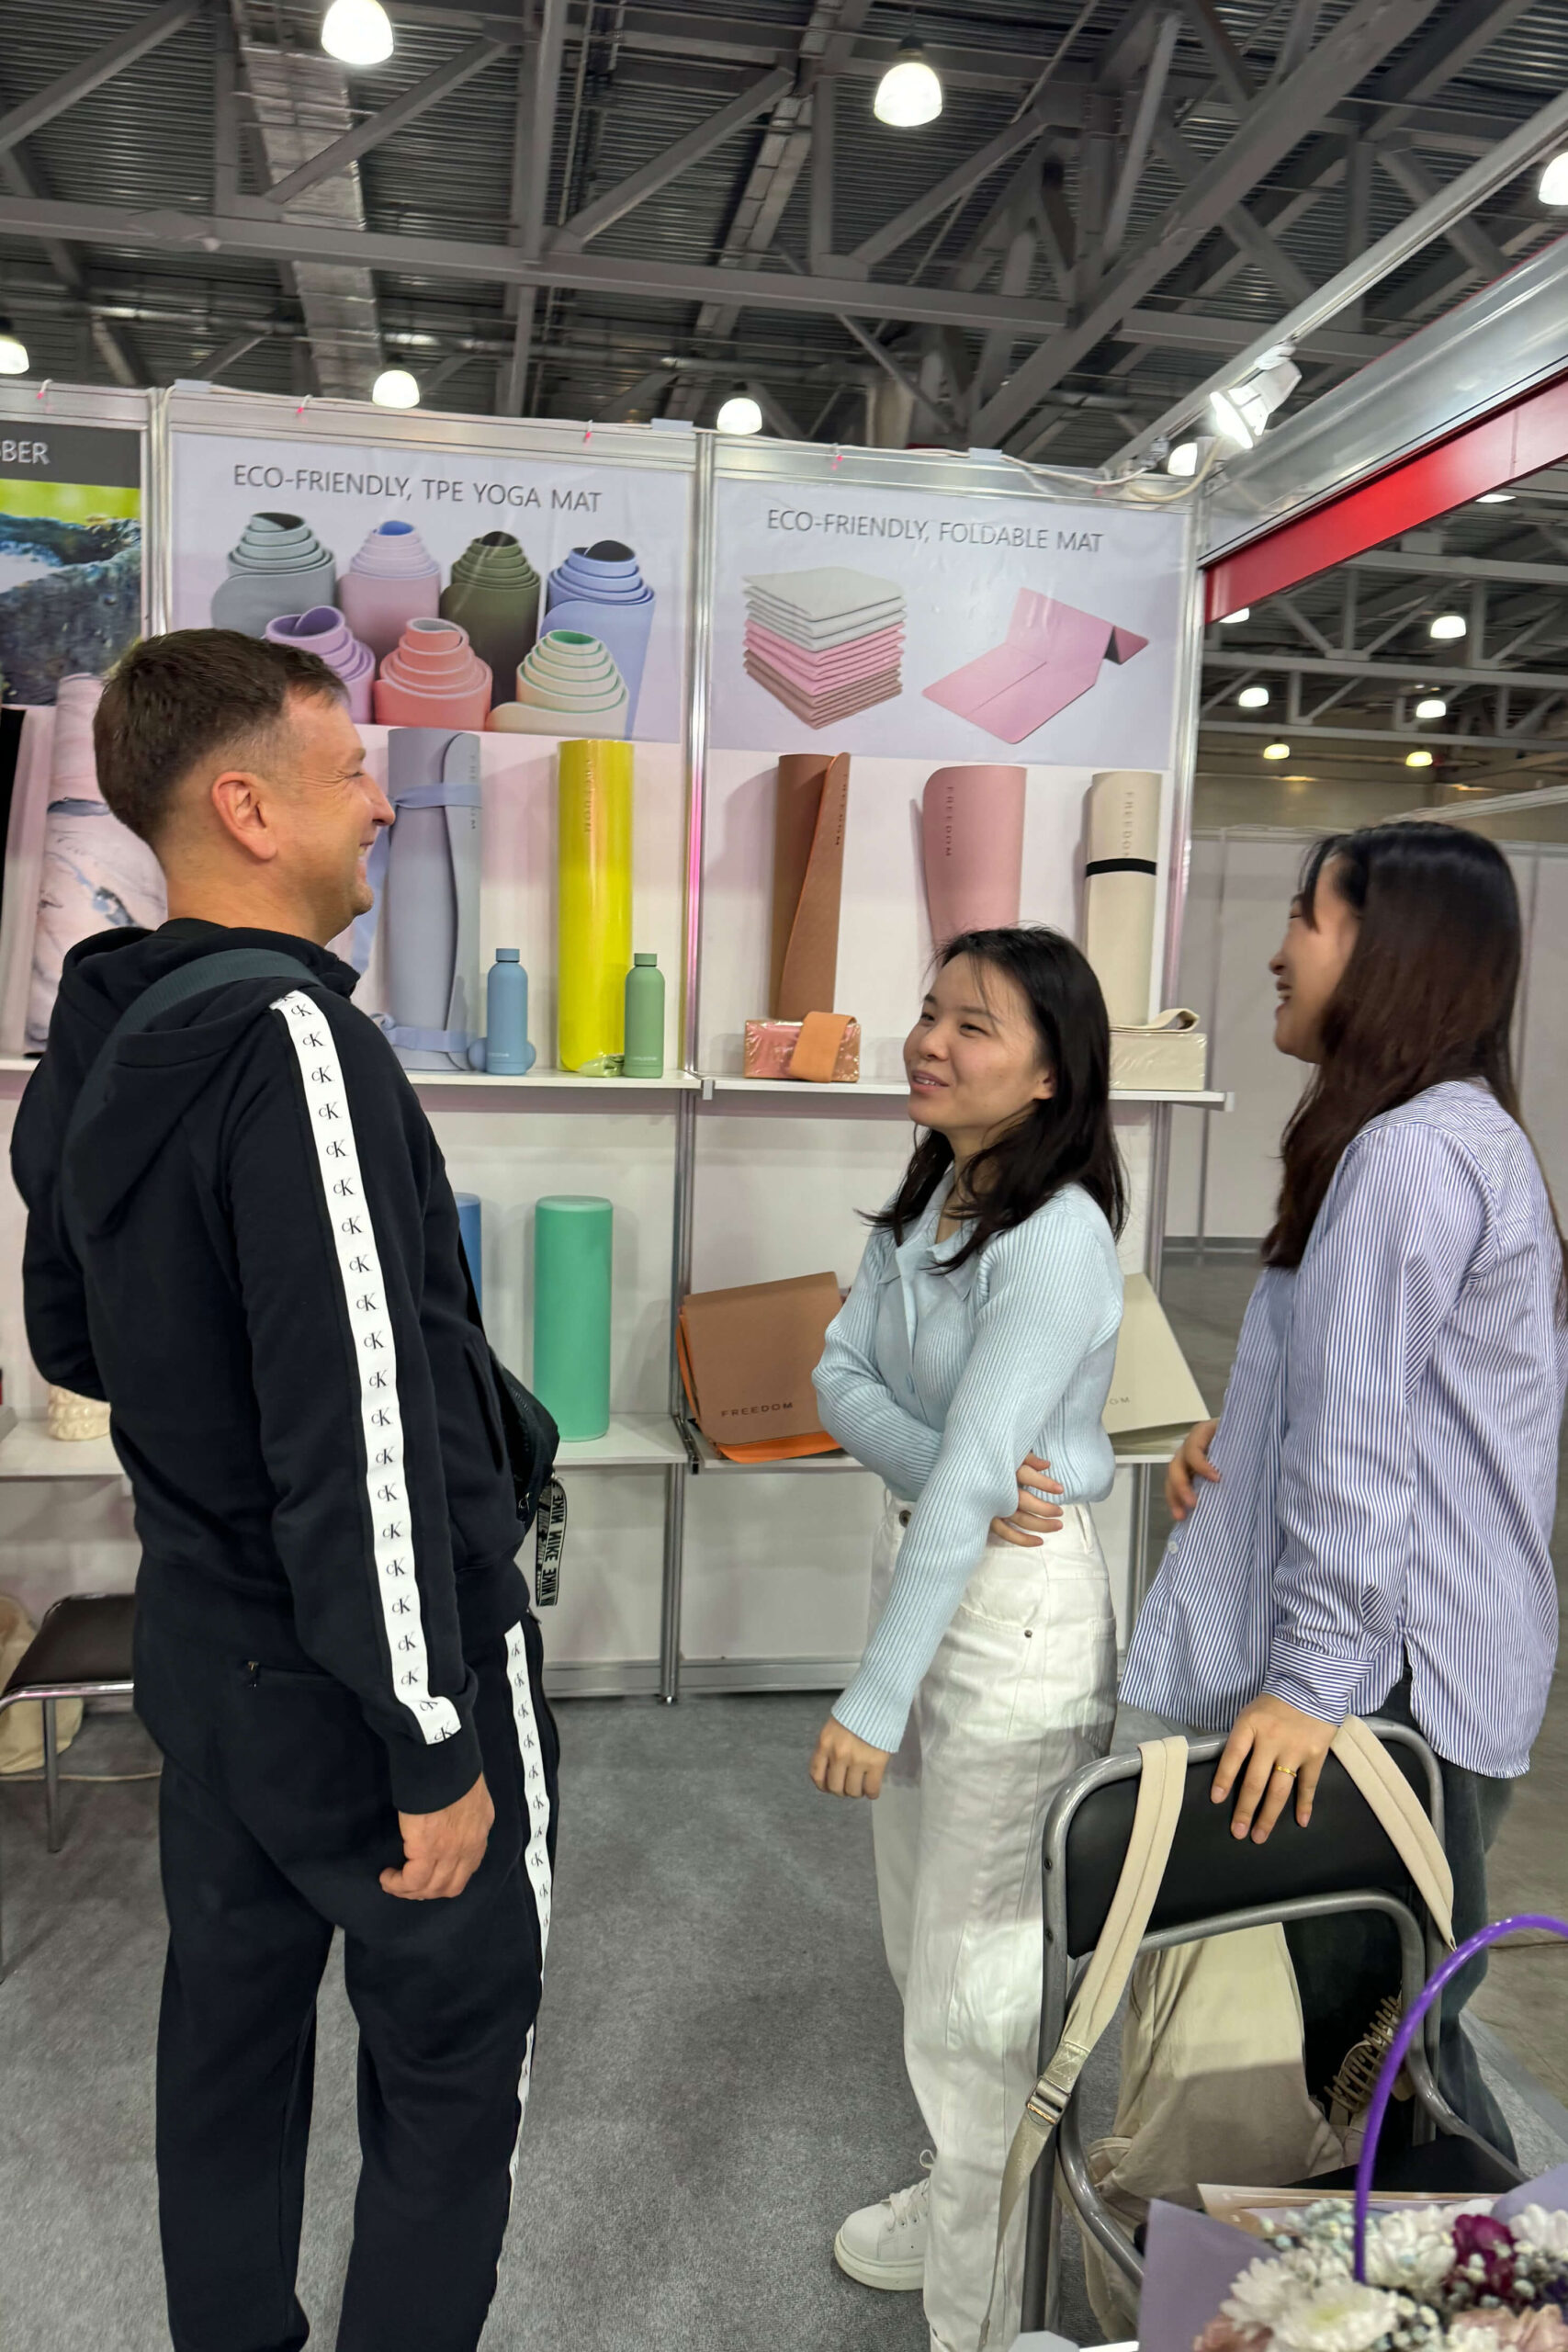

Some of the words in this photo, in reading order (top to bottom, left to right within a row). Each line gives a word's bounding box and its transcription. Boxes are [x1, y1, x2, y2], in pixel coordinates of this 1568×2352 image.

[0, 440, 51, 465] BER
[233, 464, 412, 502] ECO-FRIENDLY,
[422, 479, 464, 503] TPE
[472, 482, 542, 508] YOGA
[551, 489, 603, 513] MAT
[767, 509, 930, 544] ECO-FRIENDLY,
[939, 521, 1049, 549] FOLDABLE
[1057, 530, 1105, 553] MAT
[720, 1402, 793, 1418] FREEDOM
